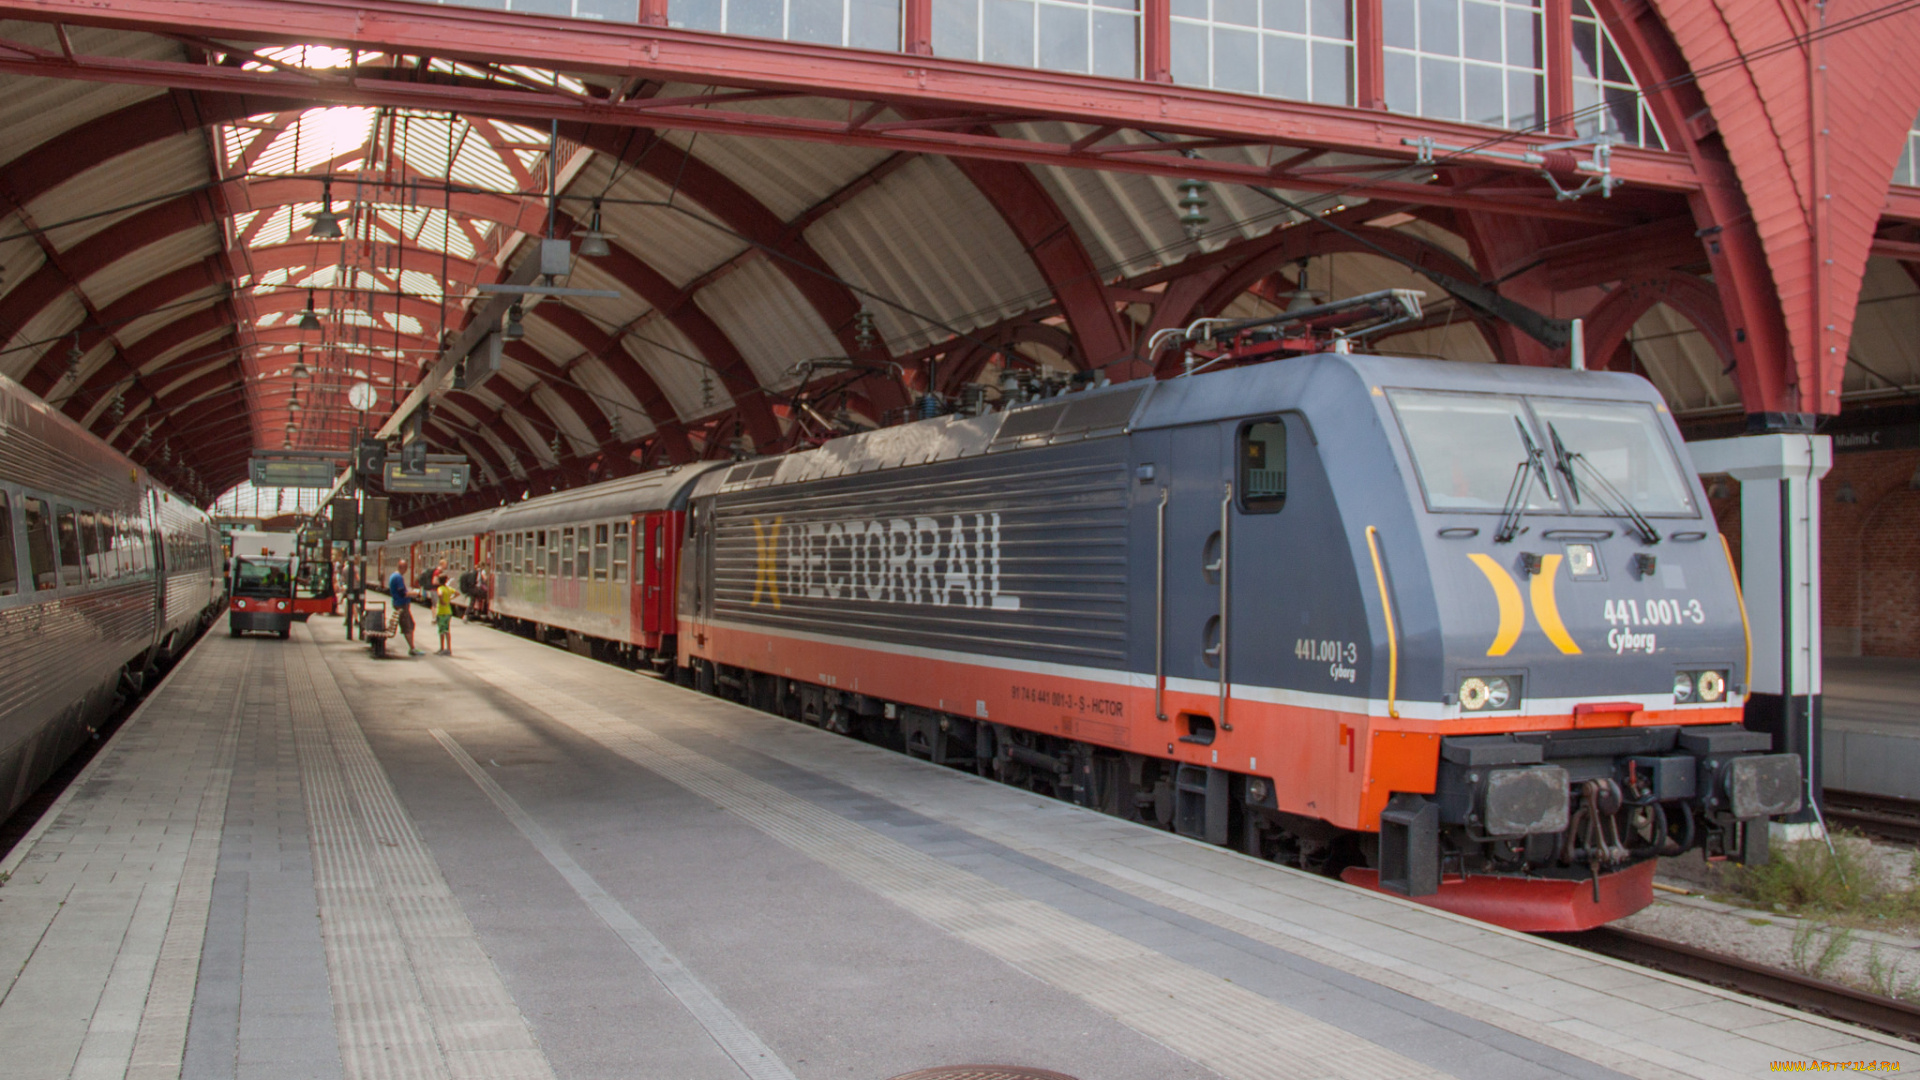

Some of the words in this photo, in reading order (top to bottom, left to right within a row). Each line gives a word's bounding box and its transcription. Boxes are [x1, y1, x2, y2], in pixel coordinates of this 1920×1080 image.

[1871, 430, 1881, 445] C
[786, 512, 1021, 611] HECTORRAIL
[1603, 598, 1706, 626] 441.001-3
[1294, 638, 1358, 664] 441.001-3
[1607, 627, 1656, 655] Cyborg
[1329, 663, 1356, 684] Cyborg
[1092, 698, 1123, 717] HCTOR
